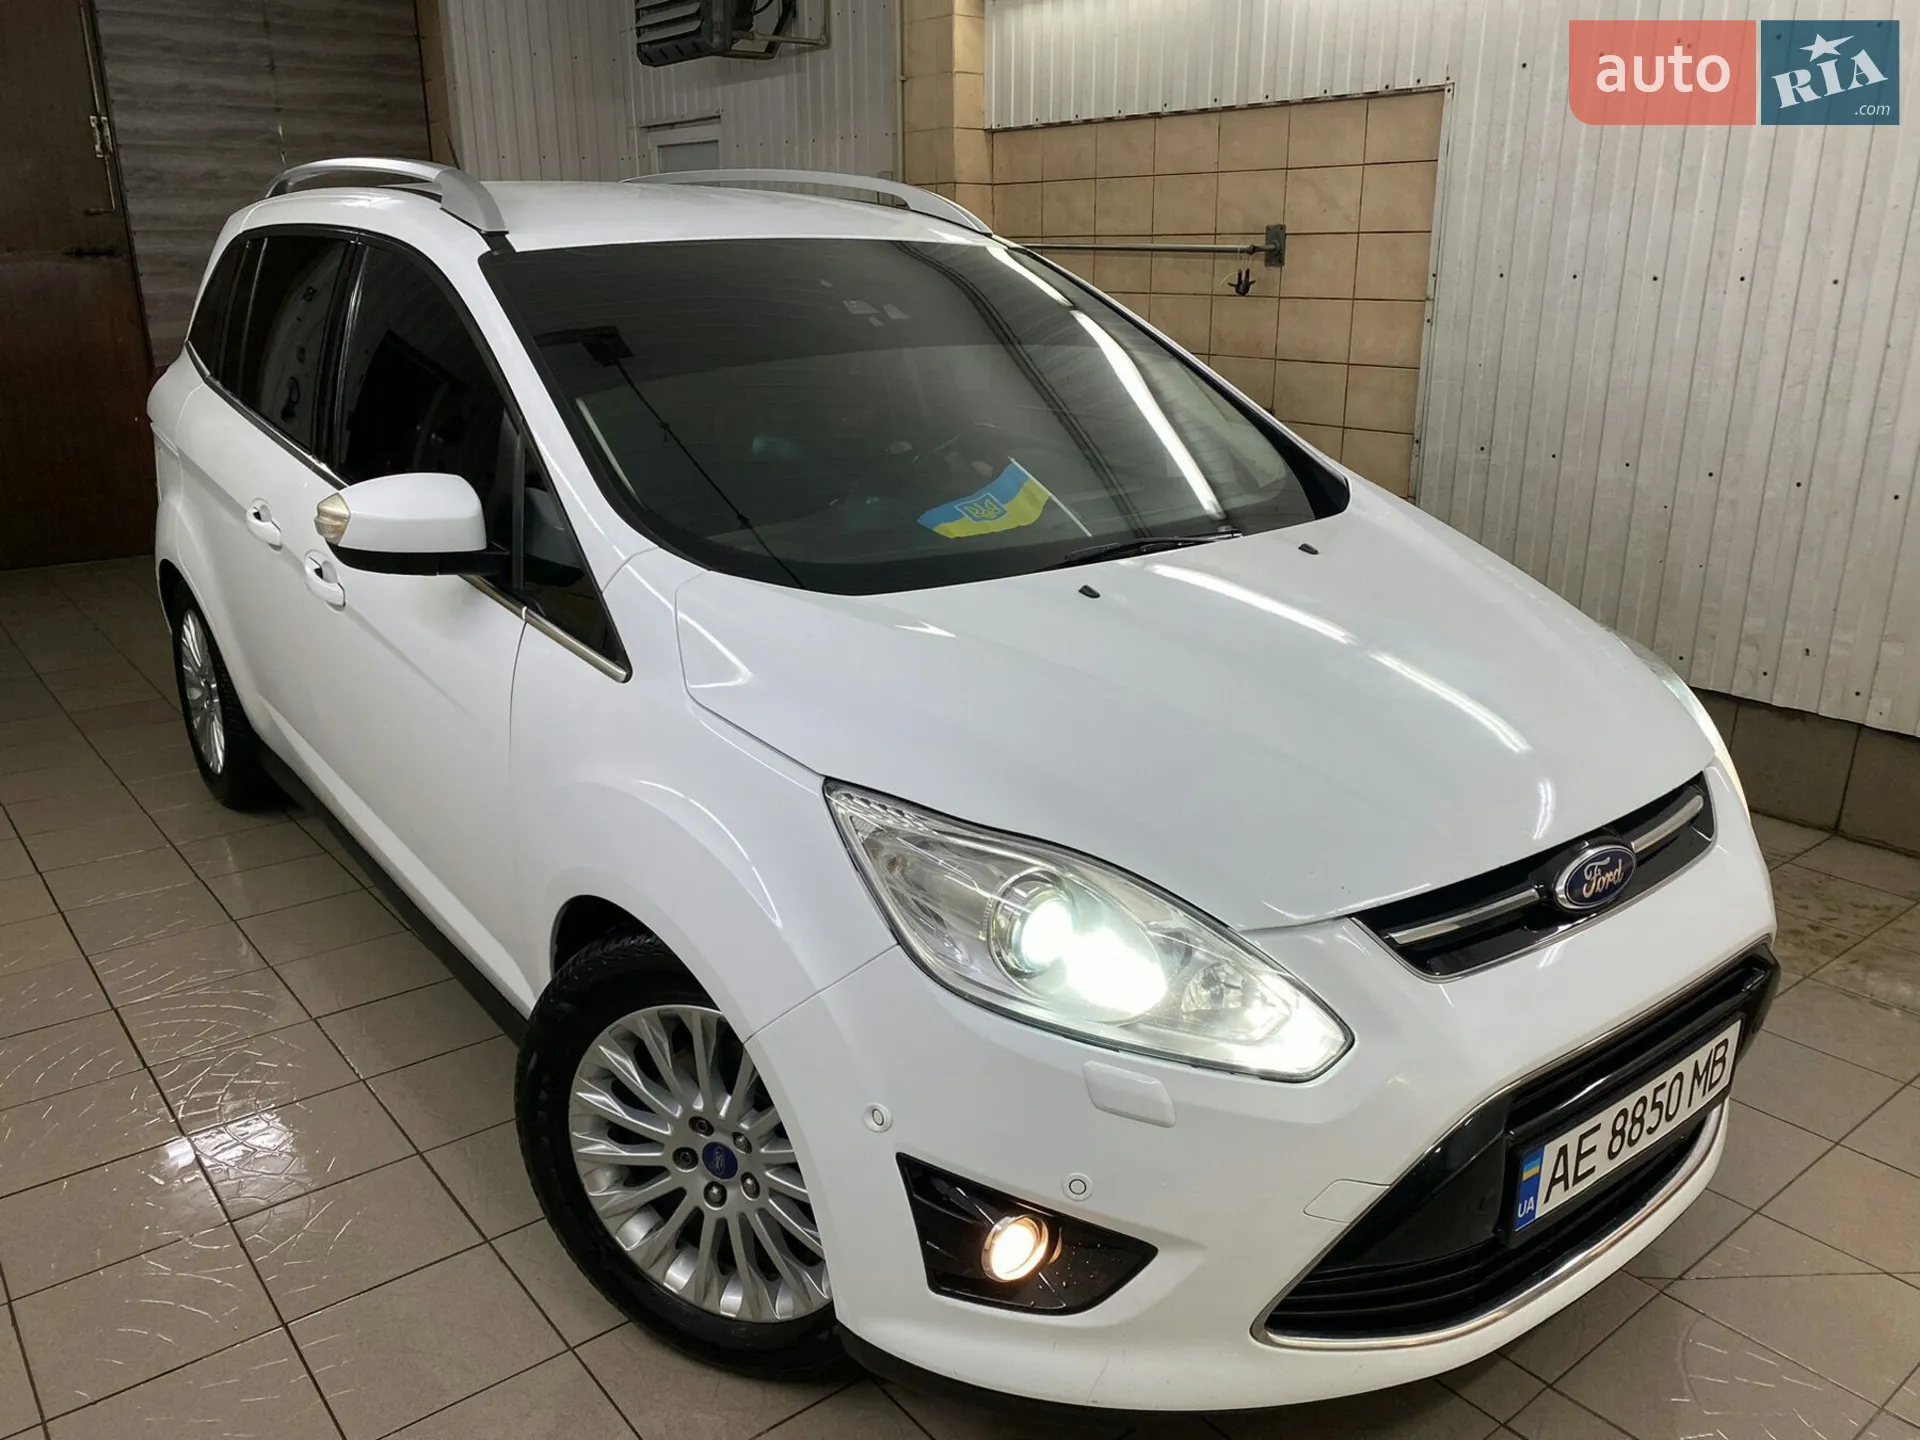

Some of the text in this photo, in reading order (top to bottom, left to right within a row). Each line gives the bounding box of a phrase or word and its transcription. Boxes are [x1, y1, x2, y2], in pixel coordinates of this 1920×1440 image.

[1582, 856, 1624, 898] Ford
[1543, 1038, 1729, 1205] AE 8850 MB
[1517, 1195, 1535, 1218] UA
